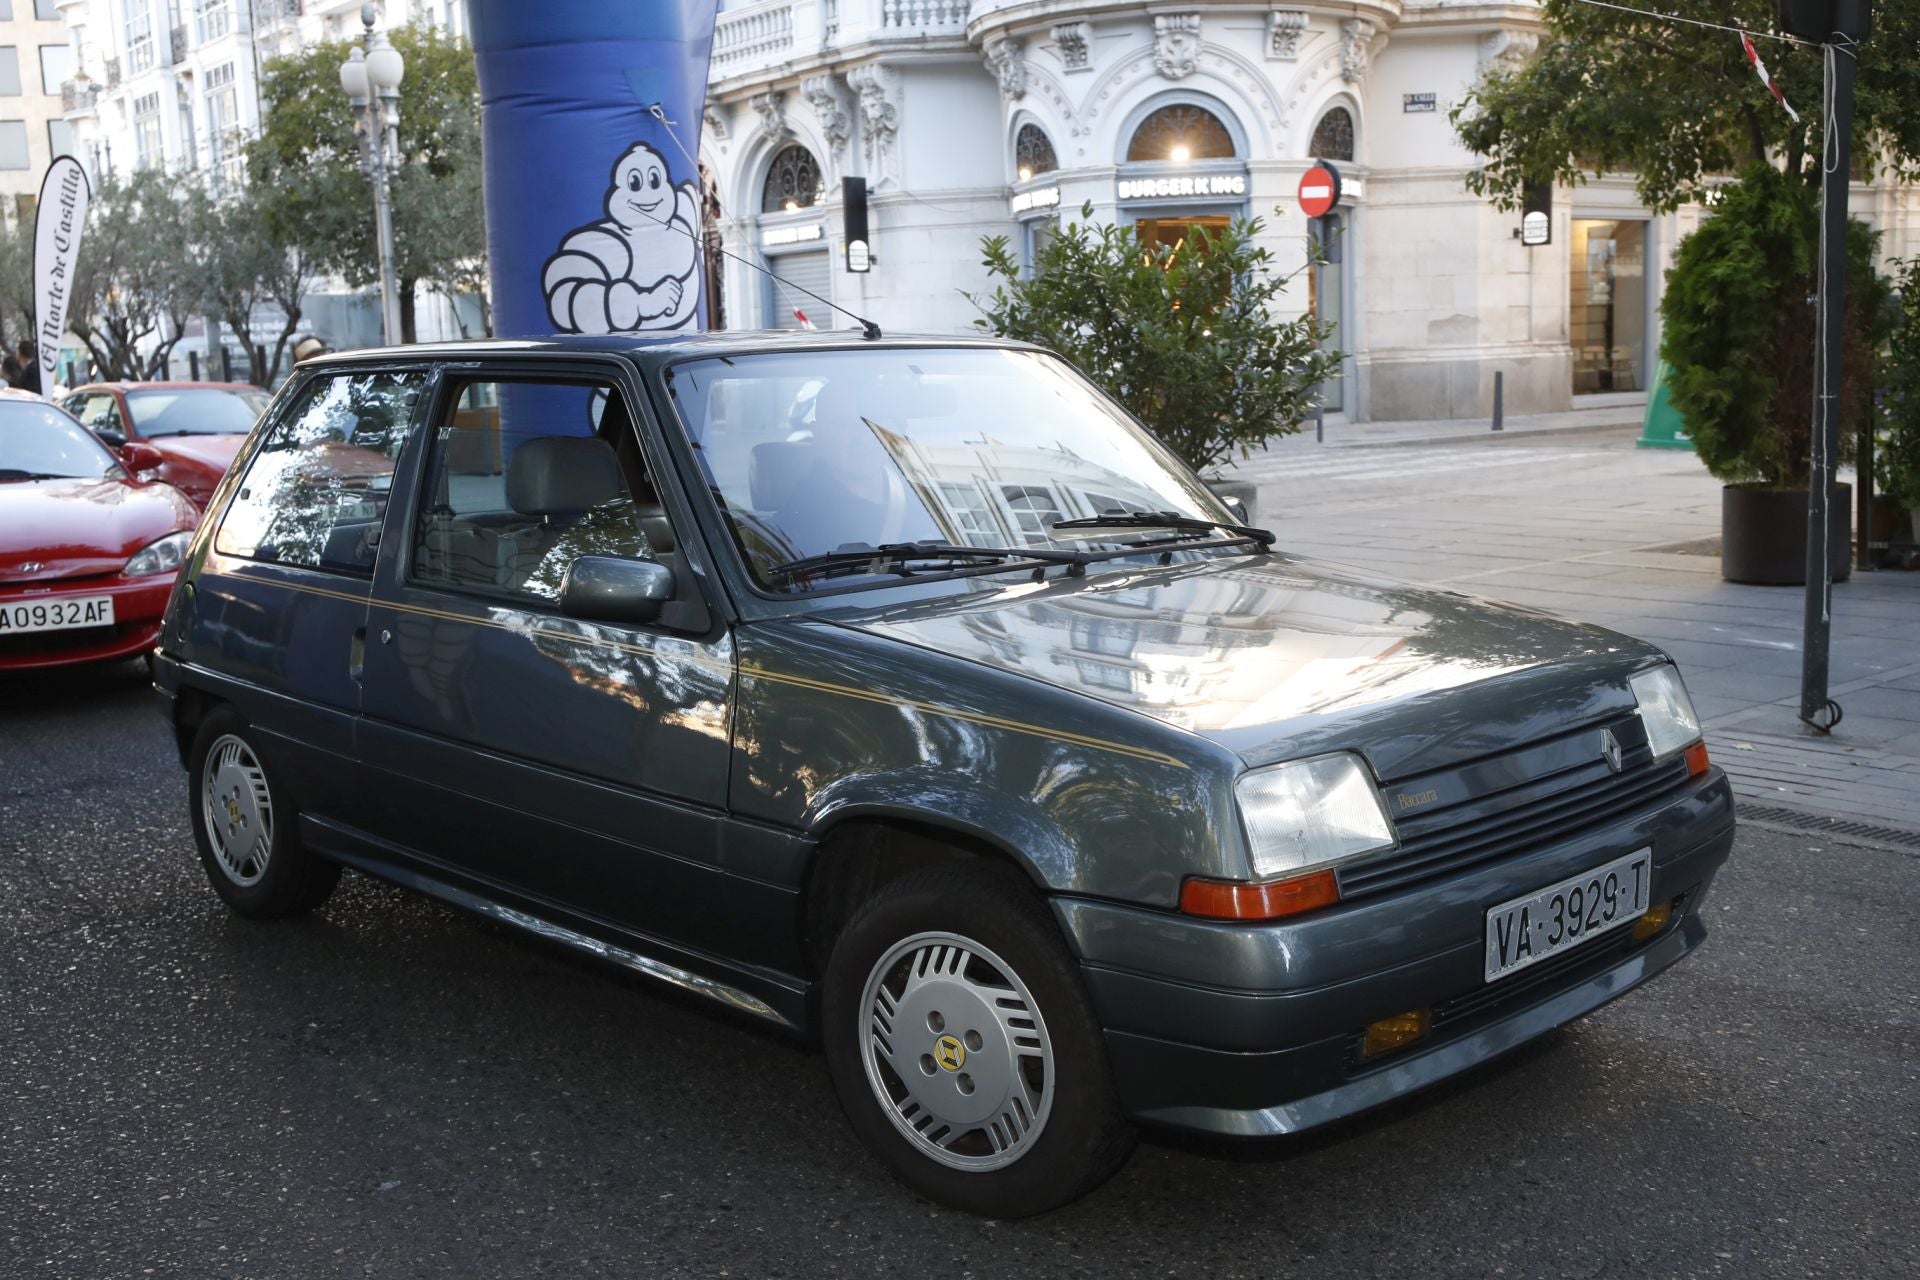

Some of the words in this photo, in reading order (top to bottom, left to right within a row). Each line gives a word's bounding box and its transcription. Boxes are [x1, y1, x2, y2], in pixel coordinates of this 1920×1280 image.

[1119, 180, 1193, 198] BURGER
[1194, 176, 1245, 194] KING
[54, 167, 81, 254] Castilla
[50, 255, 67, 279] de
[42, 281, 64, 340] Norte
[41, 343, 57, 372] El
[1396, 788, 1438, 810] Baccara
